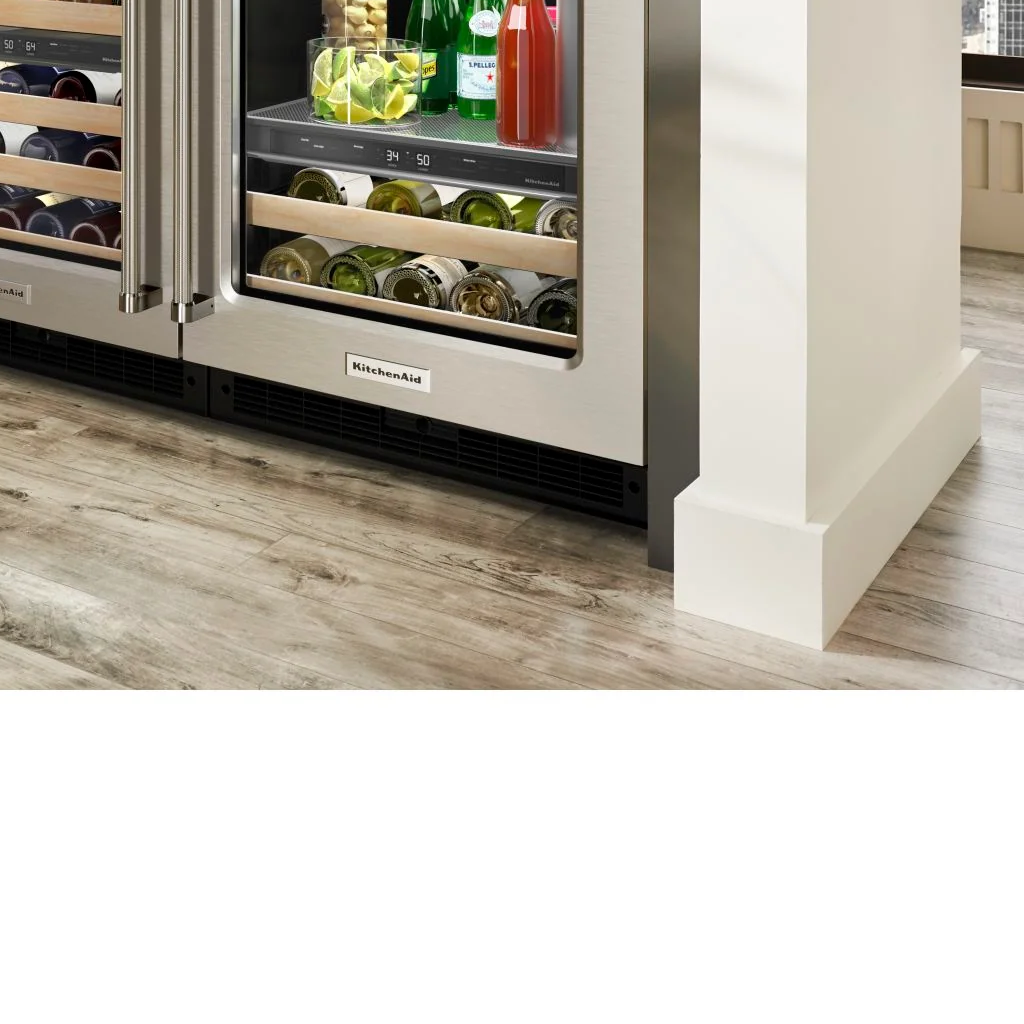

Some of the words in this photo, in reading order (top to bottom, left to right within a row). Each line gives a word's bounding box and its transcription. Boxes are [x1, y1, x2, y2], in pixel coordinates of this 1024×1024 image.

[4, 39, 14, 50] 50
[26, 41, 36, 52] 64
[386, 149, 399, 162] 34
[416, 153, 430, 166] 50
[352, 362, 422, 384] KitchenAid
